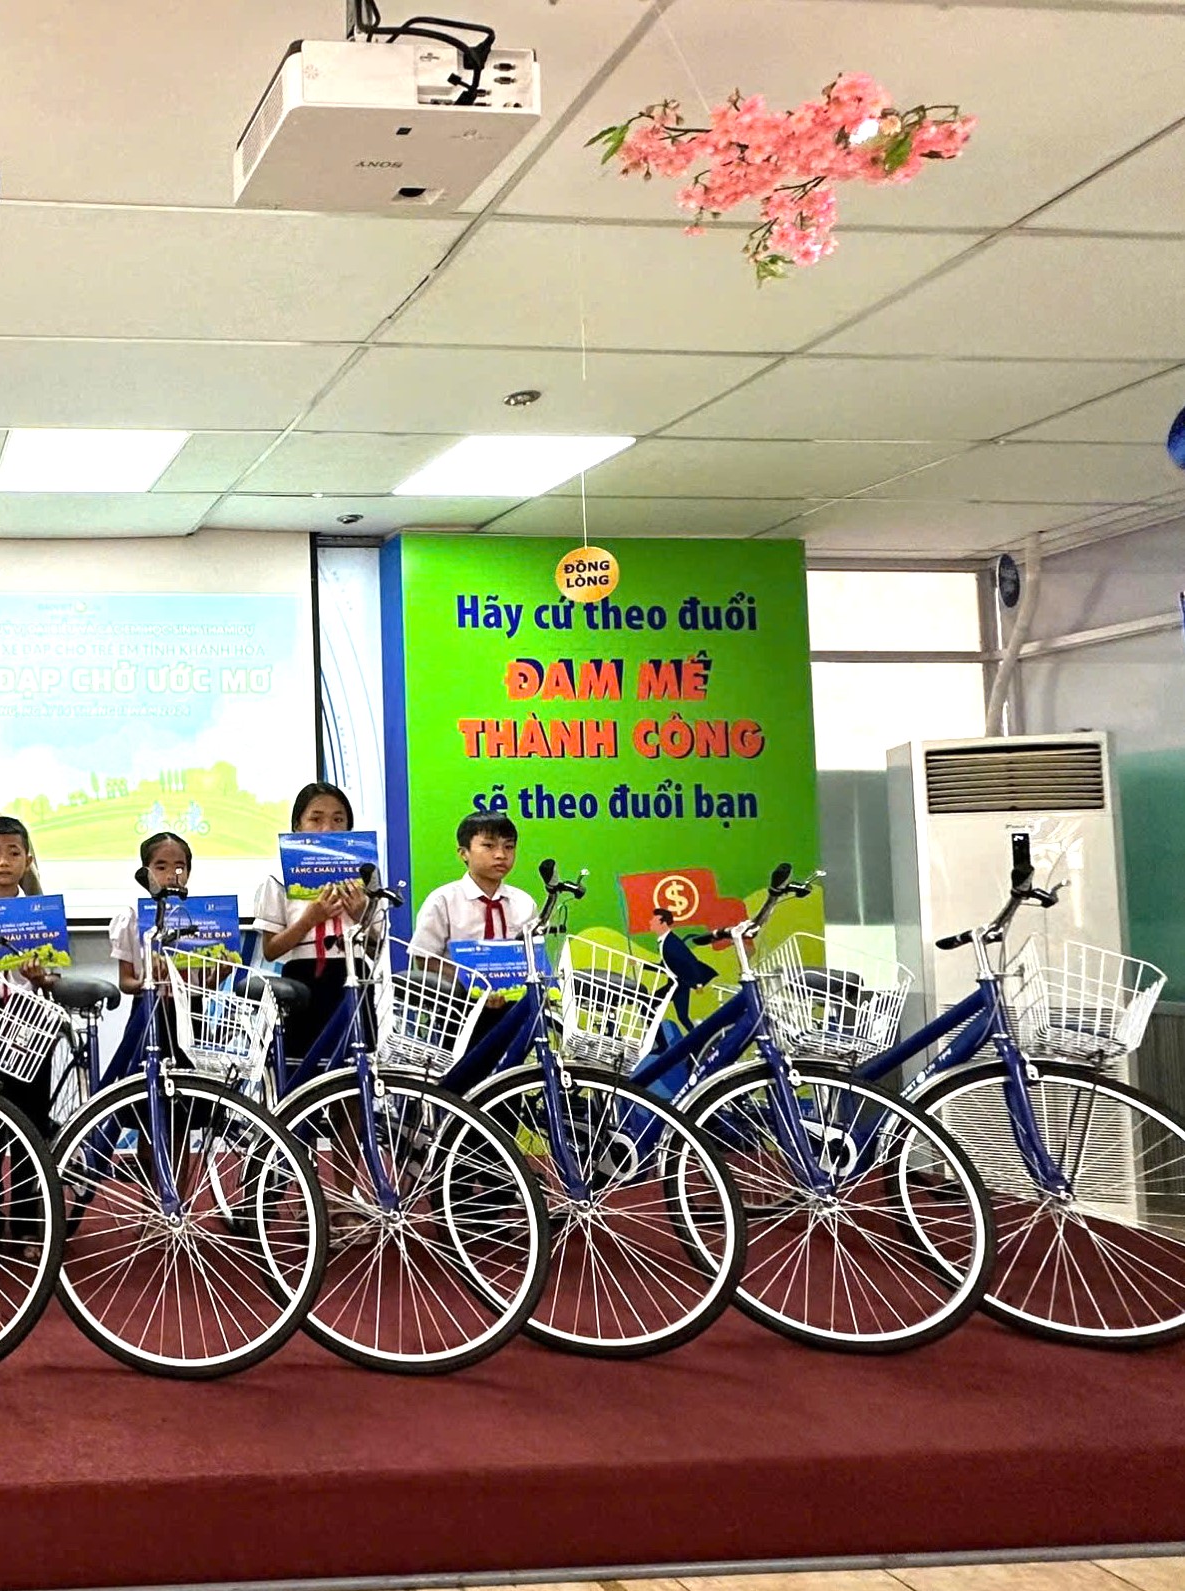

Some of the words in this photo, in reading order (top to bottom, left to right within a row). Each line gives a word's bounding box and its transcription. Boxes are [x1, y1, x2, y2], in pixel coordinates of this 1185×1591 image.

[355, 160, 403, 169] SONY
[563, 558, 611, 574] ĐỒNG
[565, 573, 610, 588] LÒNG
[456, 593, 523, 638] Hãy
[533, 592, 575, 631] cứ
[584, 597, 668, 631] theo
[678, 591, 758, 631] đuổi
[71, 660, 139, 694] CHỞ
[145, 660, 211, 694] ƯỚC
[220, 664, 273, 694] MƠ
[503, 657, 623, 702] ĐAM
[637, 649, 713, 702] MÊ
[457, 712, 618, 759] THÀNH
[632, 712, 766, 759] CÔNG
[473, 784, 509, 817] sẽ
[519, 783, 598, 819] theo
[609, 779, 683, 819] đuổi
[695, 784, 758, 829] bạn
[4, 933, 21, 941] HÁU
